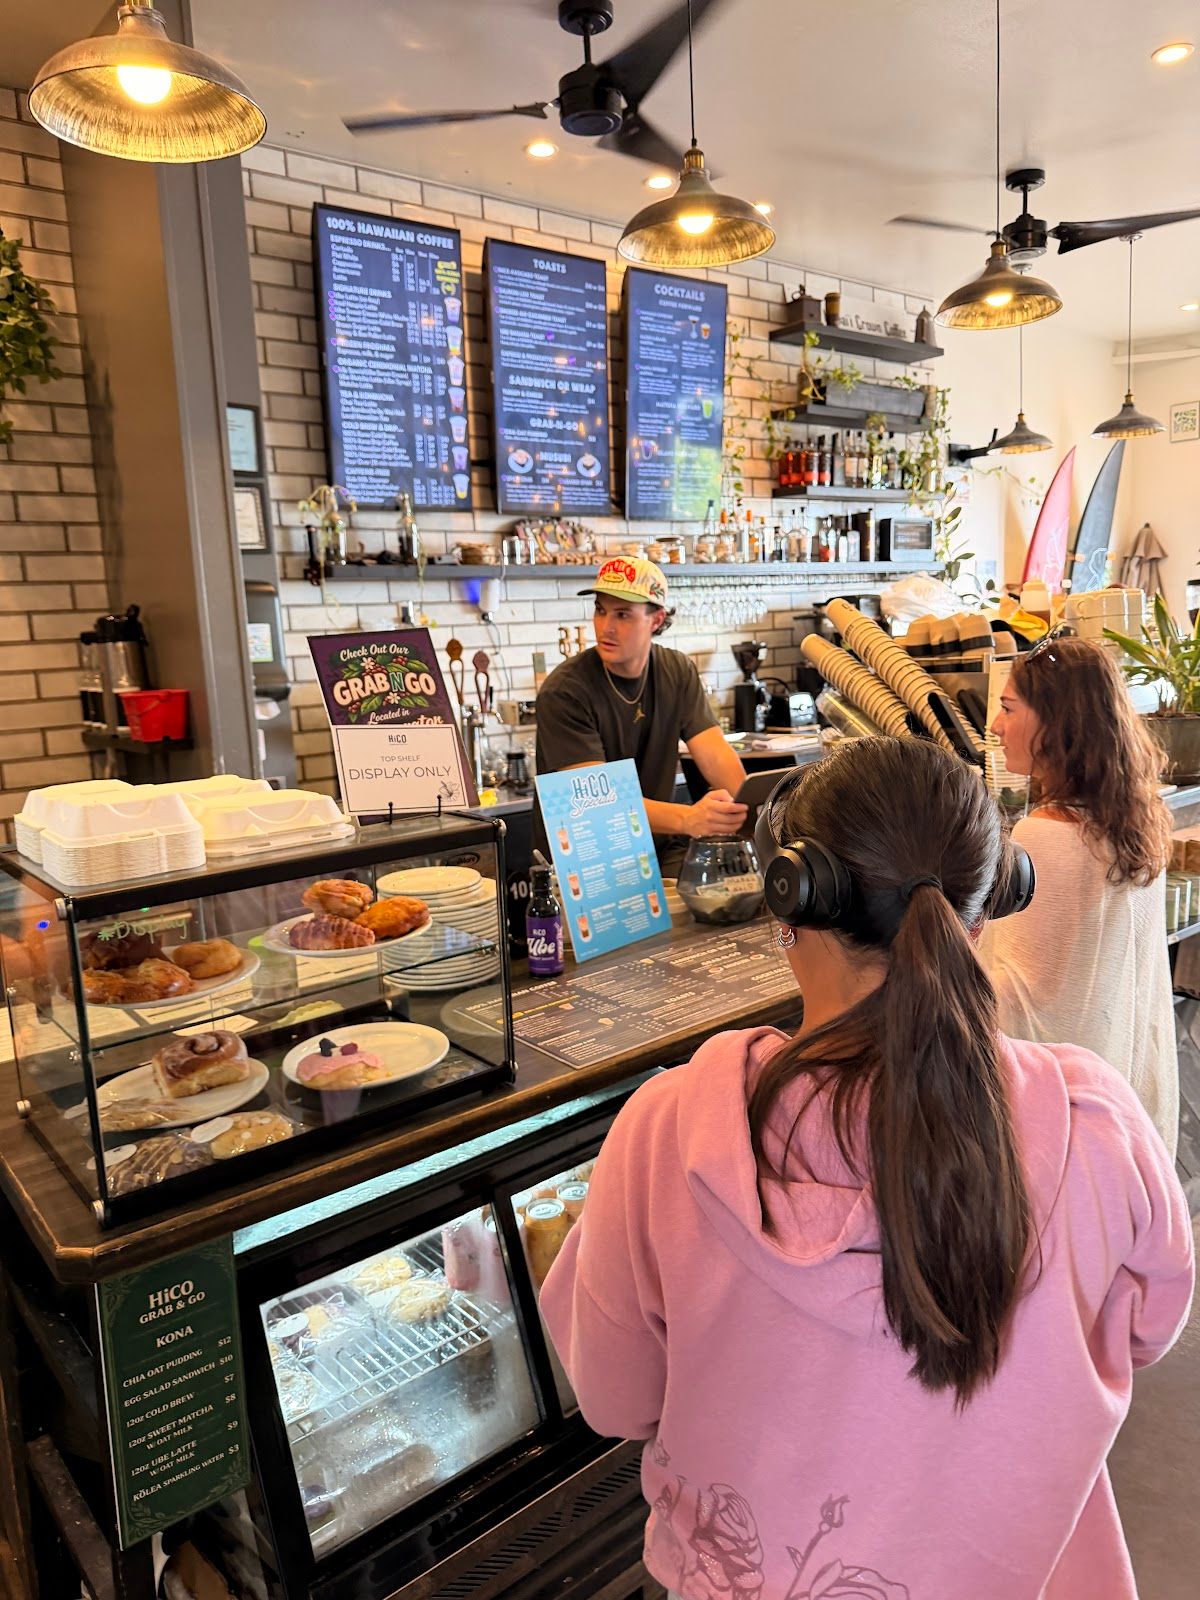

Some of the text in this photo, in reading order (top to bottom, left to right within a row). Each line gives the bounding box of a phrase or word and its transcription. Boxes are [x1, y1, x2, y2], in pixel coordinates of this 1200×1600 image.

[326, 216, 454, 250] 100% HAWAIIAN COFFEE
[532, 258, 567, 274] TOASTS
[654, 283, 706, 302] COCKTAILS
[508, 374, 596, 394] SANDWICH OR WRAP
[340, 643, 410, 662] Check Out Our
[333, 671, 437, 706] GRAB N GO
[368, 708, 401, 725] Located
[401, 708, 410, 717] in
[397, 754, 421, 762] SHELF
[349, 766, 451, 780] DISPLAY ONLY
[526, 936, 556, 957] Ube
[148, 1280, 195, 1309] HiCO
[139, 1291, 206, 1324] GRAB & GO
[156, 1325, 194, 1348] KONA
[122, 1336, 232, 1388] CHIA OAT PUDDING $12
[124, 1354, 233, 1408] EGG SALAD SANDWICH $10
[145, 1403, 169, 1419] COLD
[169, 1391, 195, 1408] BREW
[224, 1373, 234, 1384] $7
[147, 1421, 177, 1440] SWEET
[178, 1404, 214, 1426] MATCHA
[225, 1393, 236, 1404] $8
[151, 1453, 170, 1467] UBE
[170, 1440, 198, 1460] LATTE
[227, 1420, 238, 1431] $9
[156, 1434, 172, 1446] OAT
[173, 1425, 193, 1438] MILK
[159, 1461, 175, 1472] OAT
[175, 1450, 195, 1464] MILK
[163, 1465, 201, 1487] SPARKLING
[202, 1452, 225, 1468] WATER
[228, 1444, 240, 1455] $3
